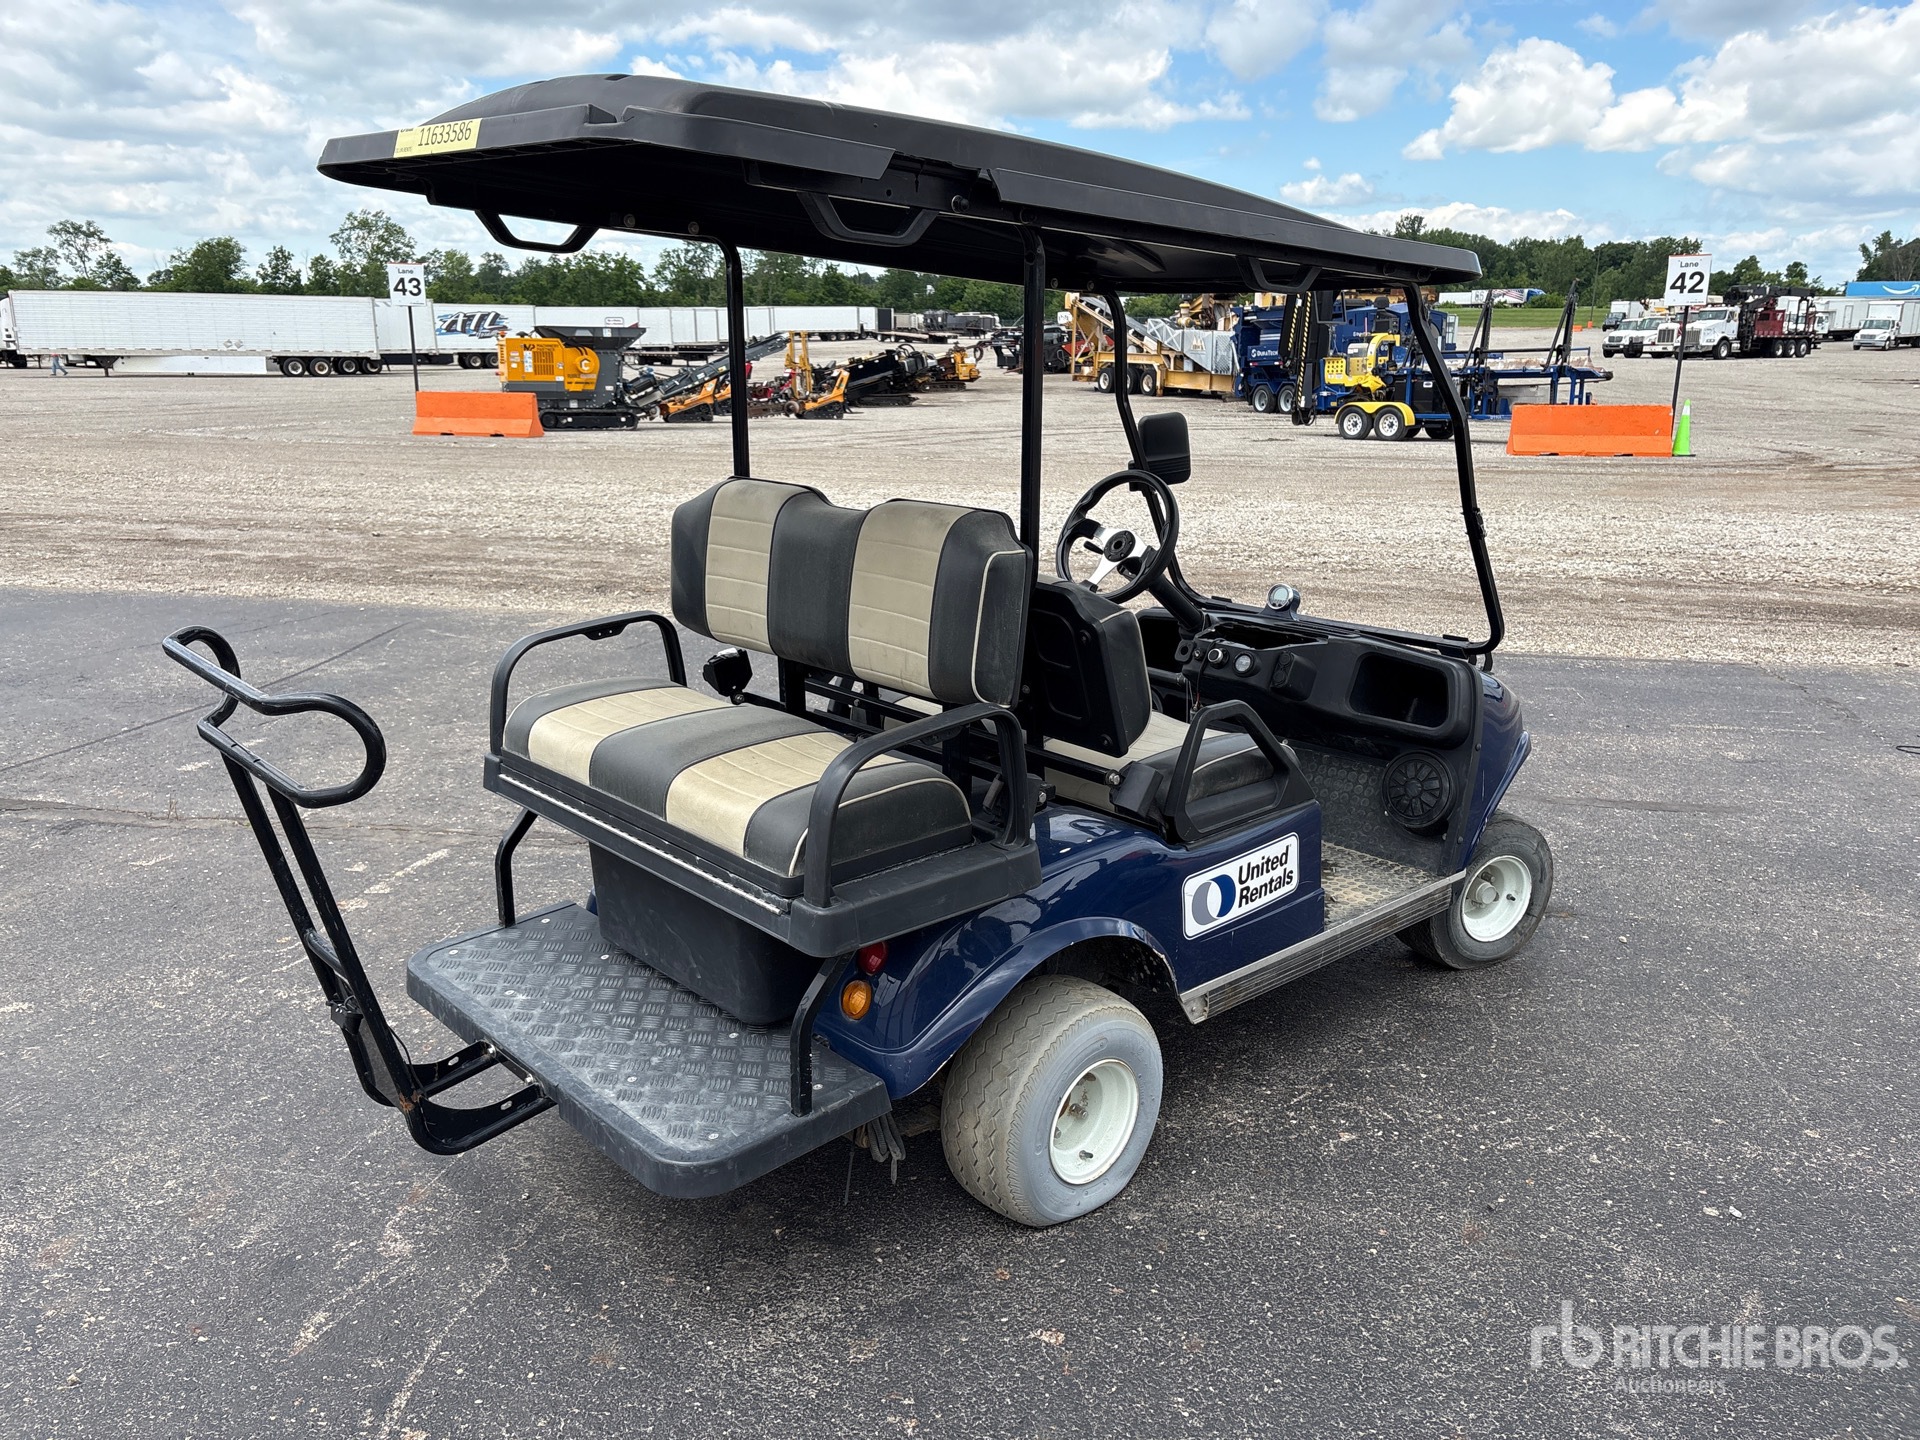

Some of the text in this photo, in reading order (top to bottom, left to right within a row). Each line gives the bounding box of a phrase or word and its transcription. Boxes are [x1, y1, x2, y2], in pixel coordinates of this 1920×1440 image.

[418, 121, 473, 146] 11633586
[393, 277, 422, 297] 43
[1669, 271, 1705, 294] 42
[1238, 845, 1290, 885] United
[1238, 867, 1294, 908] Rentals
